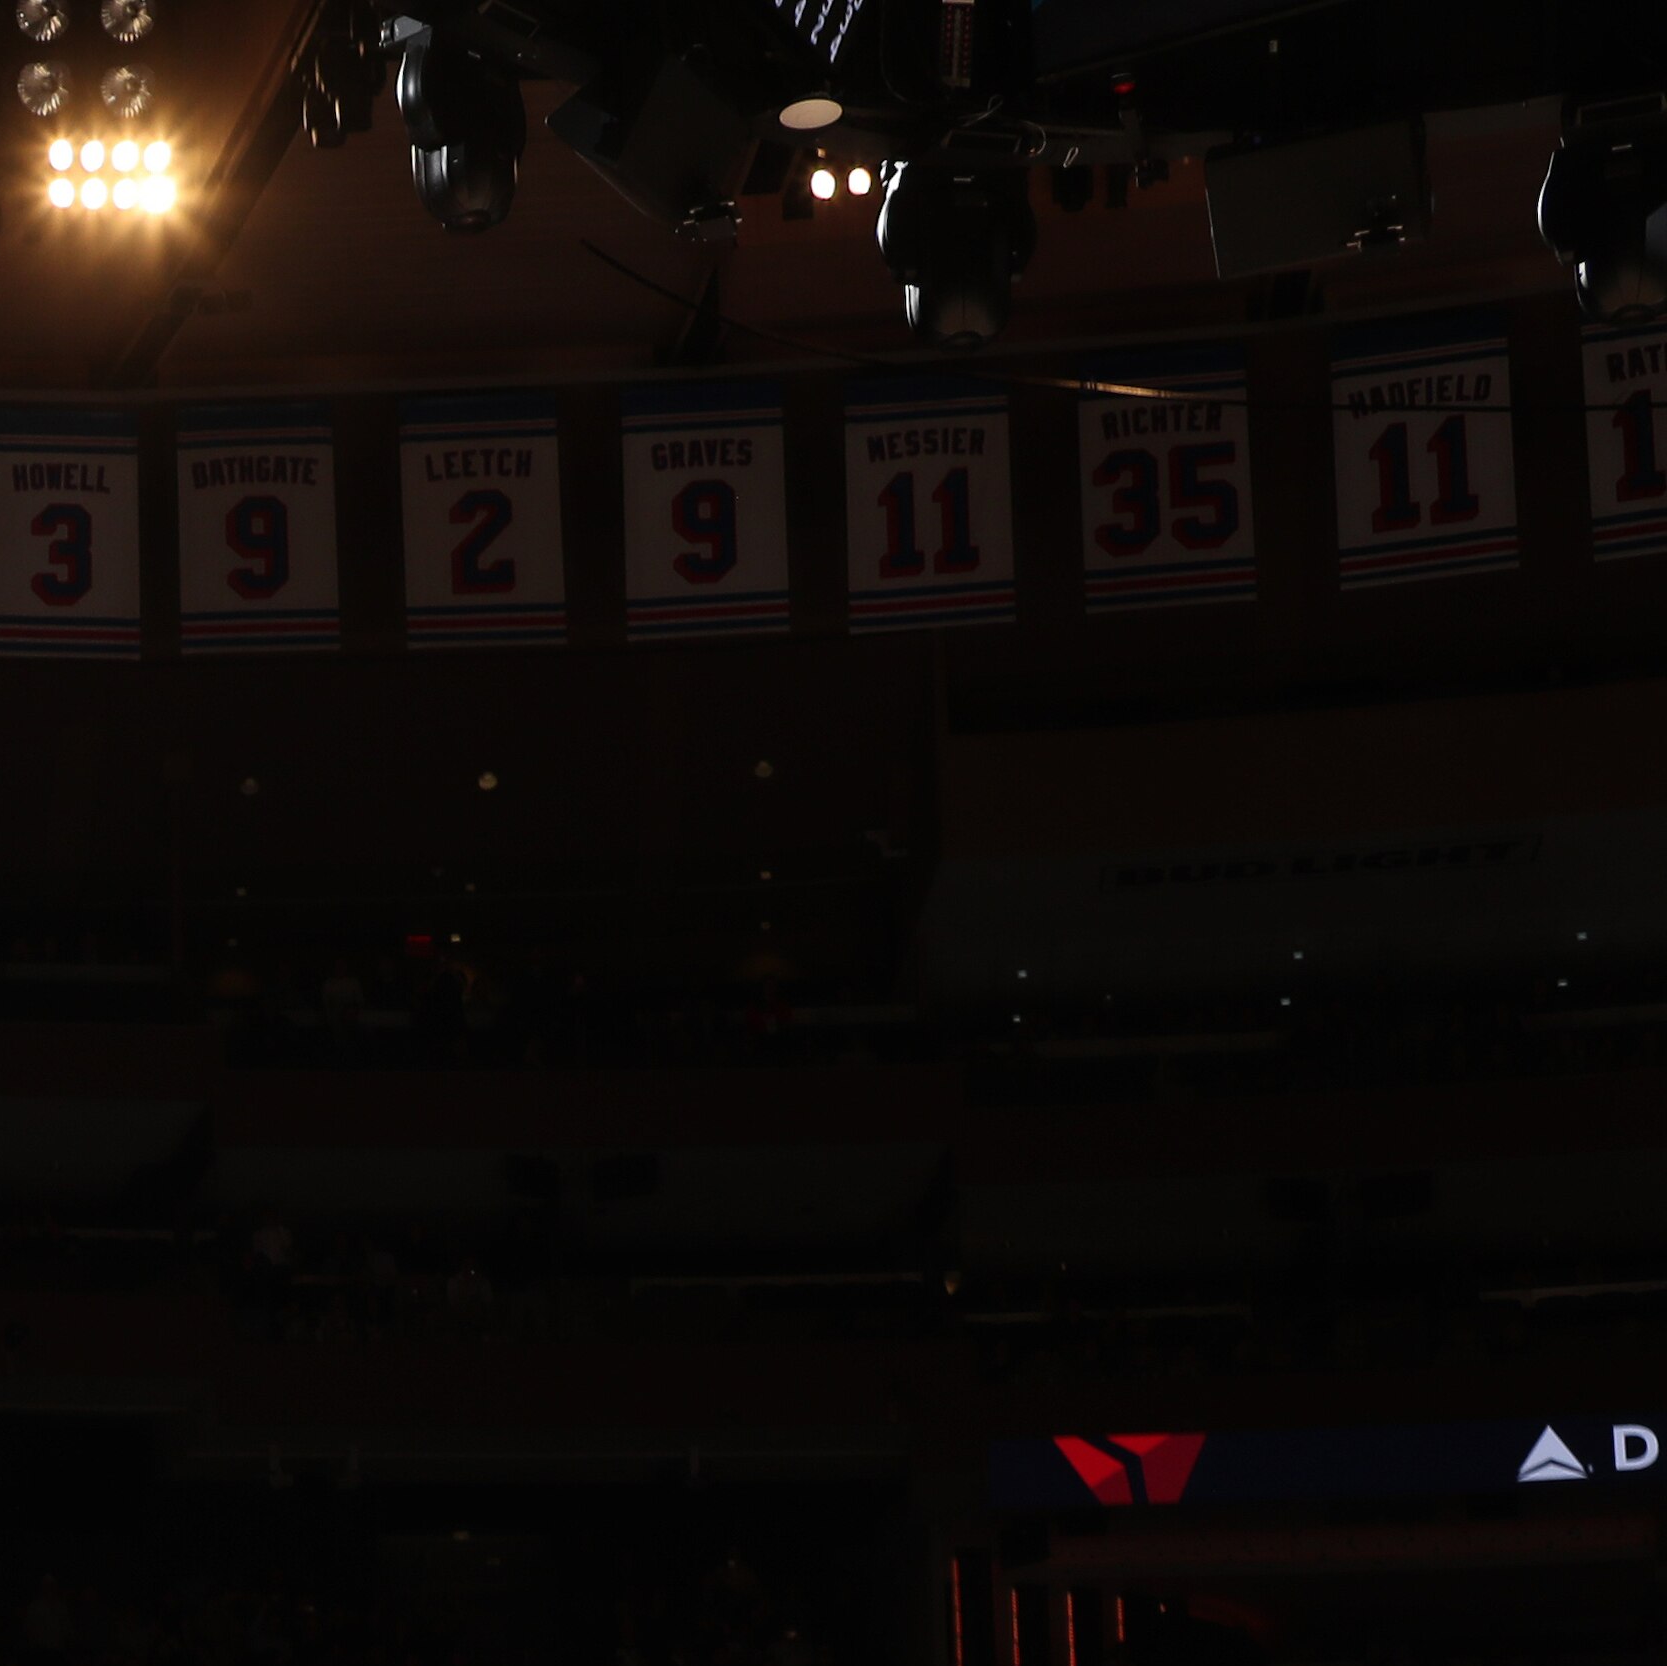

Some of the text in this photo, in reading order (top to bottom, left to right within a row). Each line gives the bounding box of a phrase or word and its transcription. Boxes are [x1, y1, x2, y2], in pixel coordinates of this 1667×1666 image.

[1606, 343, 1667, 384] RAT
[650, 438, 754, 472] GRAVES
[867, 428, 986, 463] MESSIER
[1100, 401, 1222, 440] RICHTER
[12, 463, 110, 494] HOWELL
[425, 448, 533, 482] LEETCH
[1091, 441, 1238, 557] 35
[1369, 414, 1480, 534] 11
[30, 503, 92, 607] 3
[225, 495, 288, 600] 9
[448, 488, 517, 595] 2
[671, 479, 738, 585] 9
[877, 467, 981, 579] 11
[1115, 840, 1523, 887] BUD LIGHT
